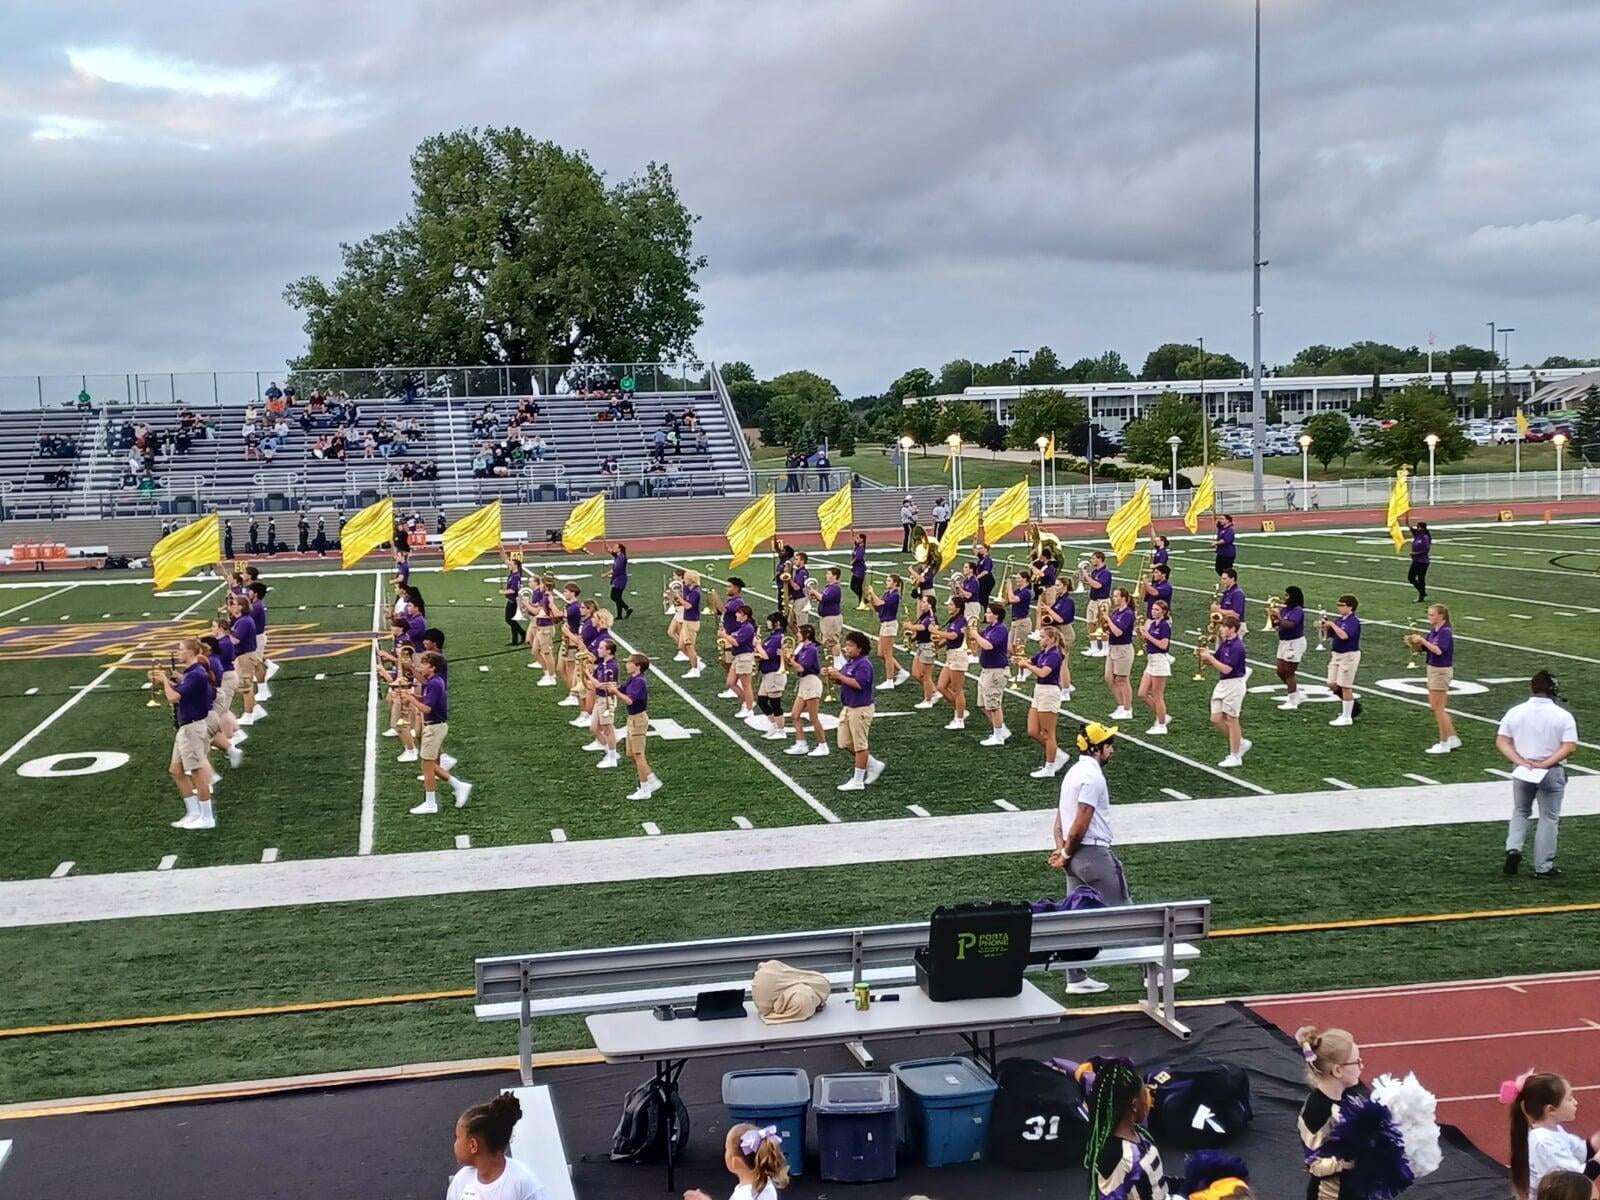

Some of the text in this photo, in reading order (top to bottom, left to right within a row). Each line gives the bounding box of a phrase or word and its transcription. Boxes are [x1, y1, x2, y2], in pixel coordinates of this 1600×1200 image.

[235, 561, 247, 572] 50
[979, 933, 1009, 941] PORTA
[978, 939, 1009, 947] PHONE
[1022, 1115, 1061, 1141] 31
